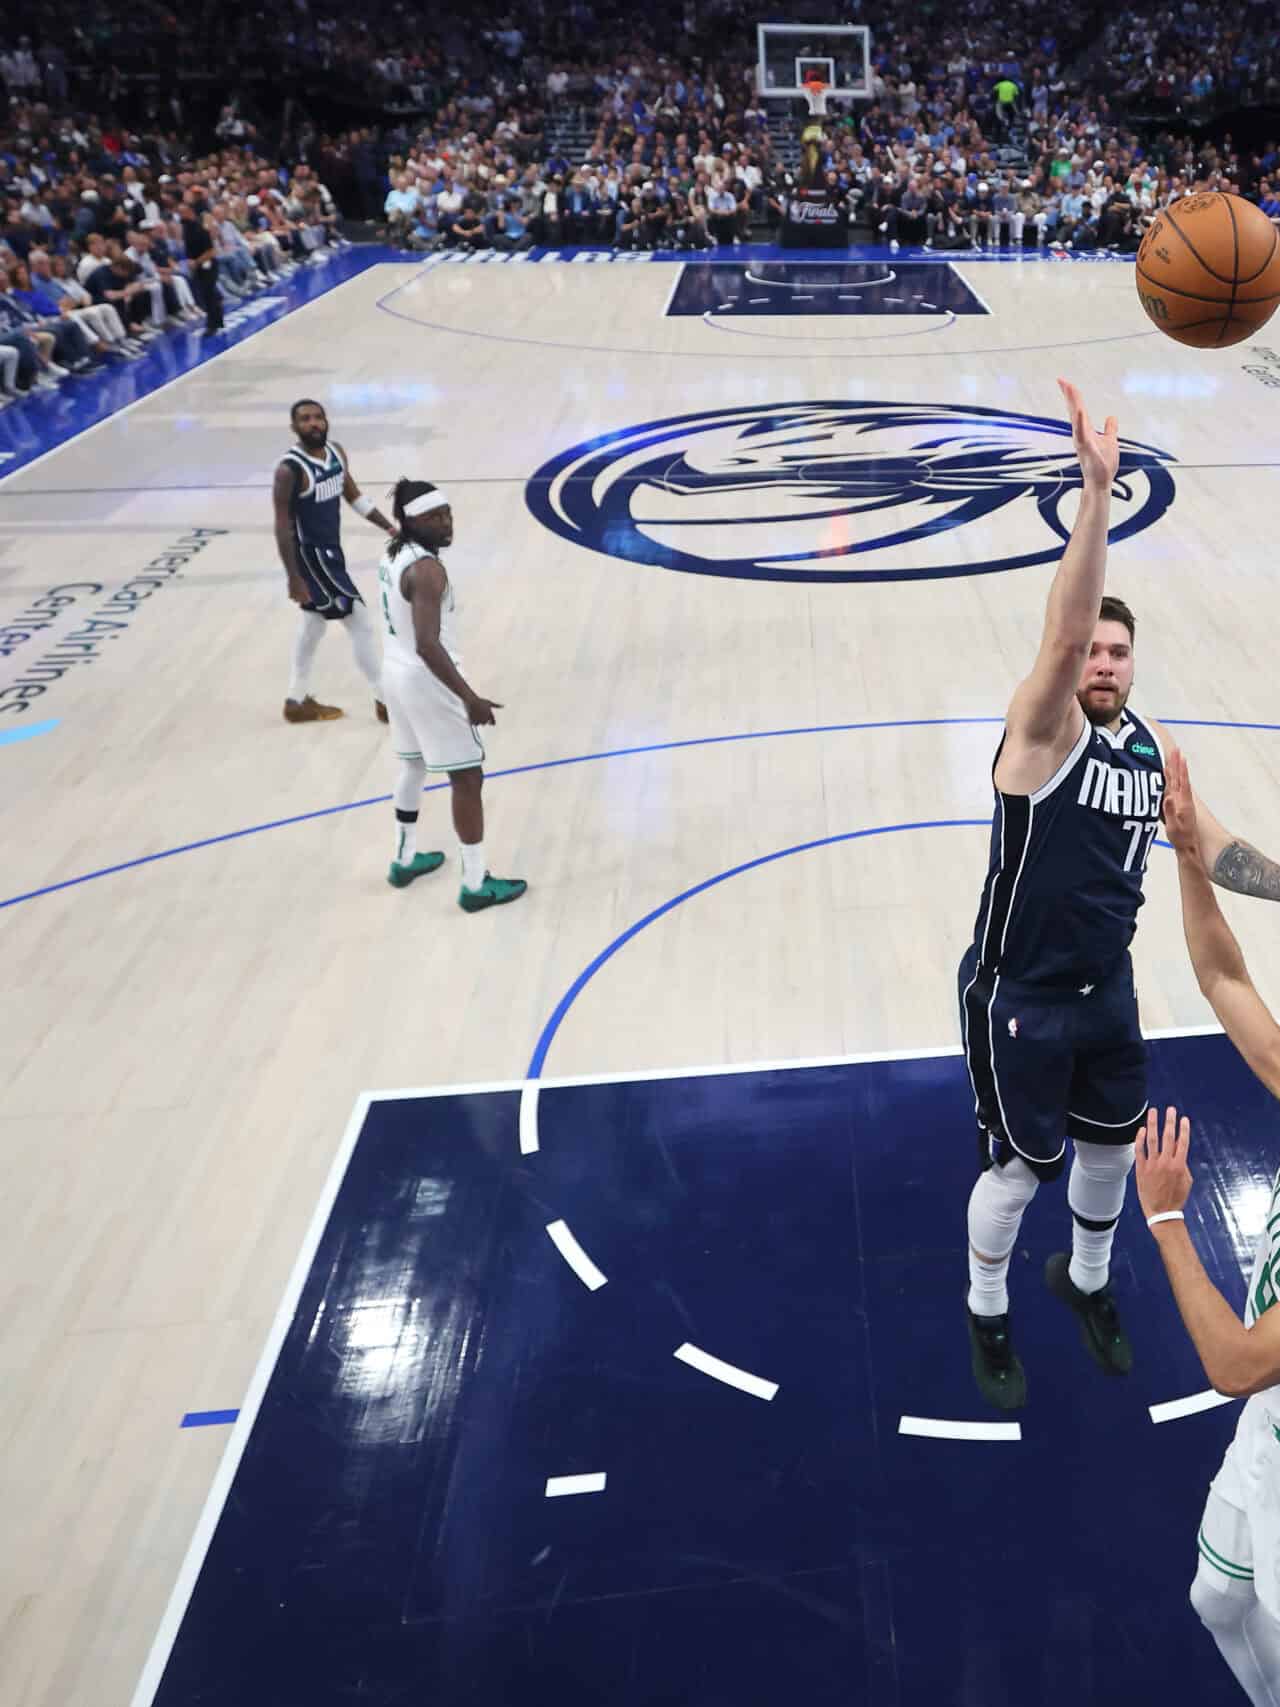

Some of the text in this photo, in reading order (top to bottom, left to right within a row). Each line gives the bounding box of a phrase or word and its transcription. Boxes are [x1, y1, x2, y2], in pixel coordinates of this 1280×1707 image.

[92, 528, 230, 615] American
[1077, 757, 1163, 817] MAVS
[1122, 820, 1159, 872] 77
